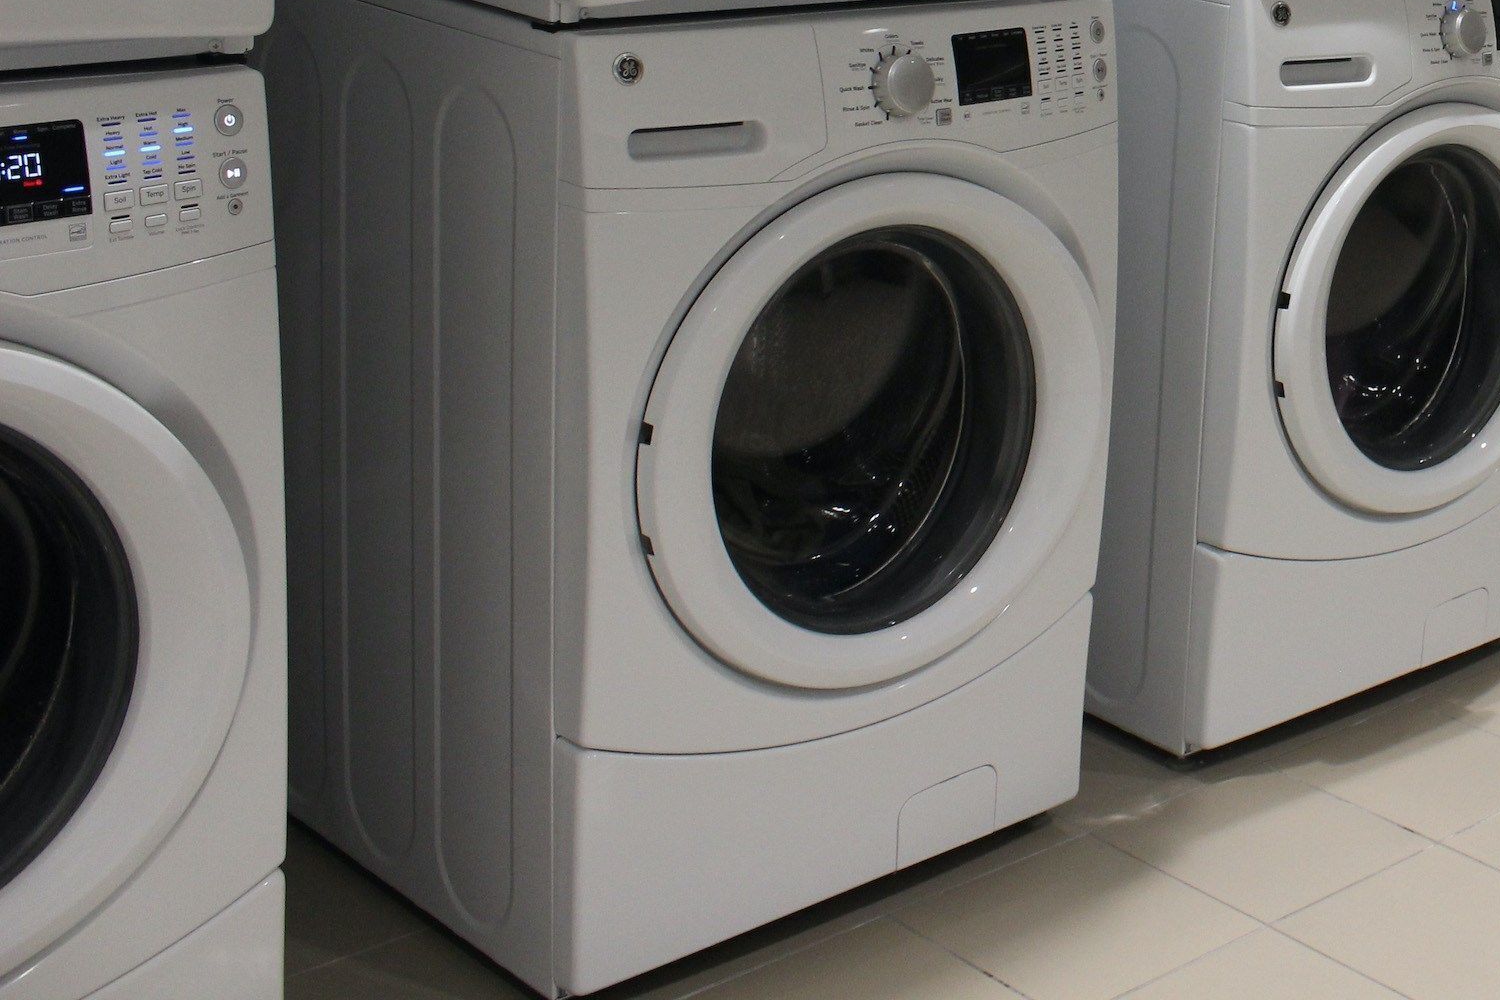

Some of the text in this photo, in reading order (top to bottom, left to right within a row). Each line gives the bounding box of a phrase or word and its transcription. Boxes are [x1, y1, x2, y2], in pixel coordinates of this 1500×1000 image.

[182, 185, 196, 193] Spin
[146, 190, 164, 199] Temp
[114, 196, 127, 204] Soil
